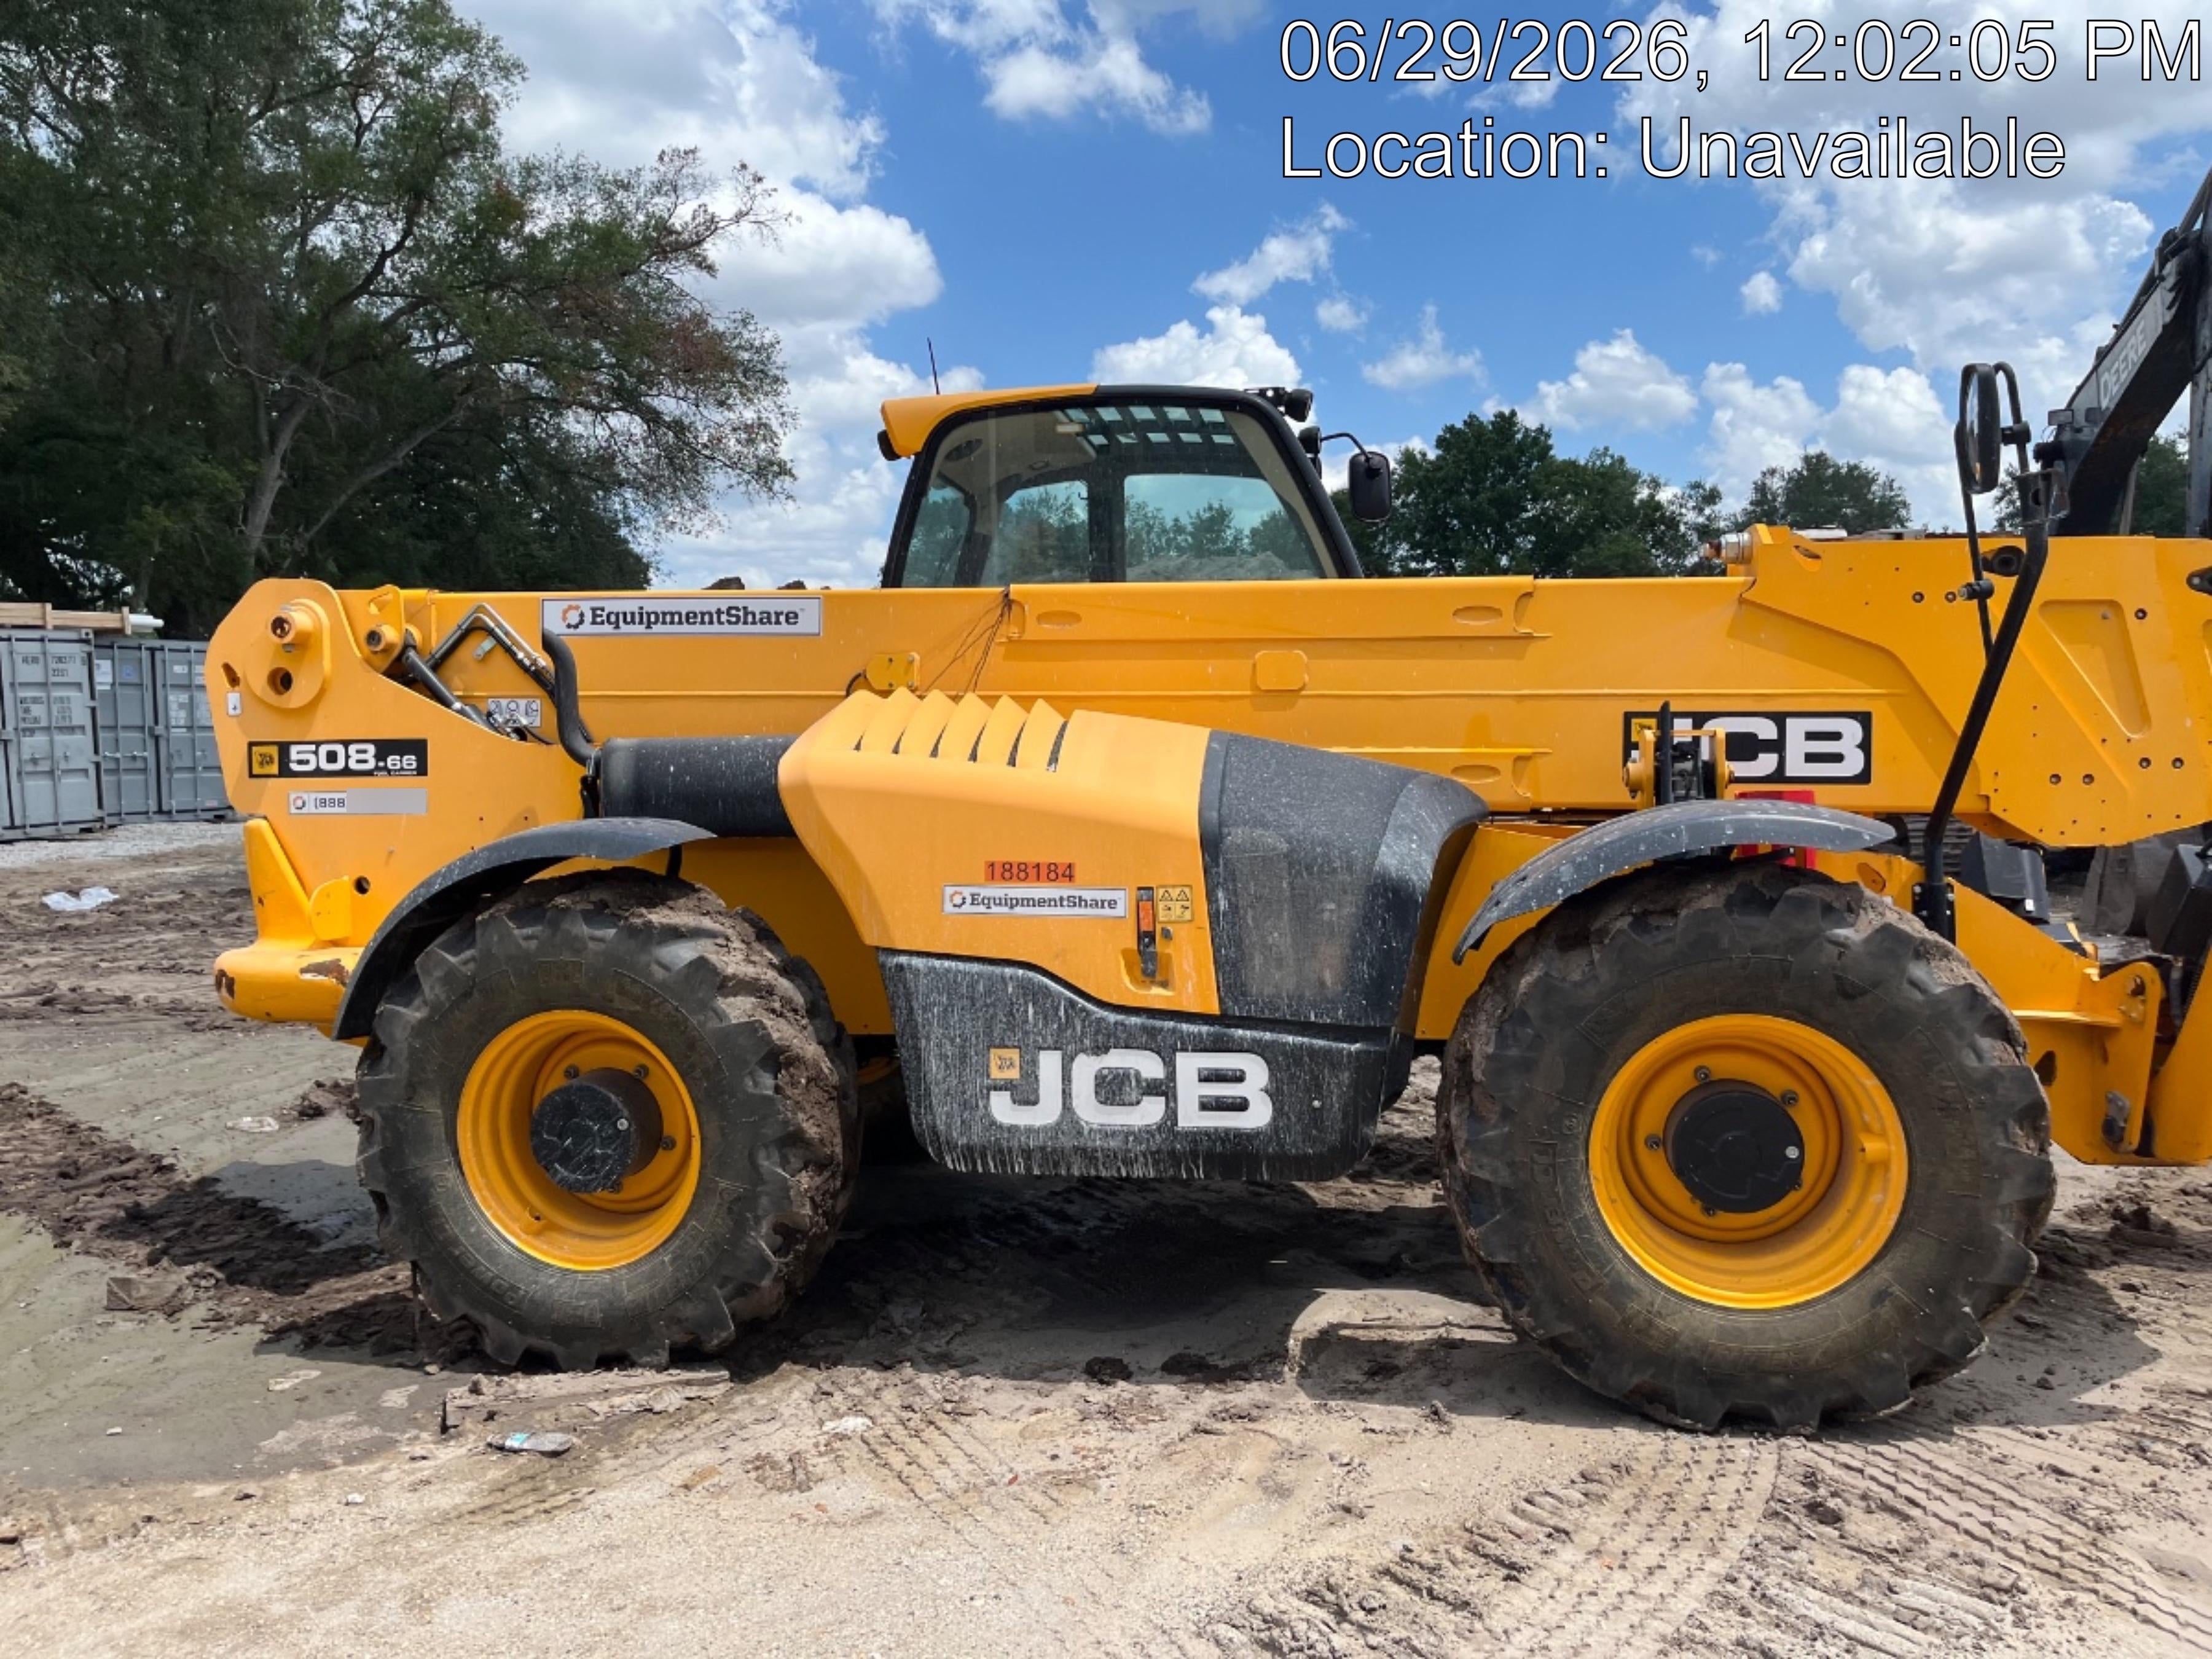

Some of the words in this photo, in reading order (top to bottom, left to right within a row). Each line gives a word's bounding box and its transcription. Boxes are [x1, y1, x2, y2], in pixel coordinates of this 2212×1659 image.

[2100, 319, 2147, 411] DEERE
[590, 606, 799, 630] EquipmentShare
[289, 743, 417, 771] 508-66
[987, 861, 1075, 882] 188184
[969, 893, 1118, 910] EquipmentShare
[989, 1048, 1273, 1128] JCB
